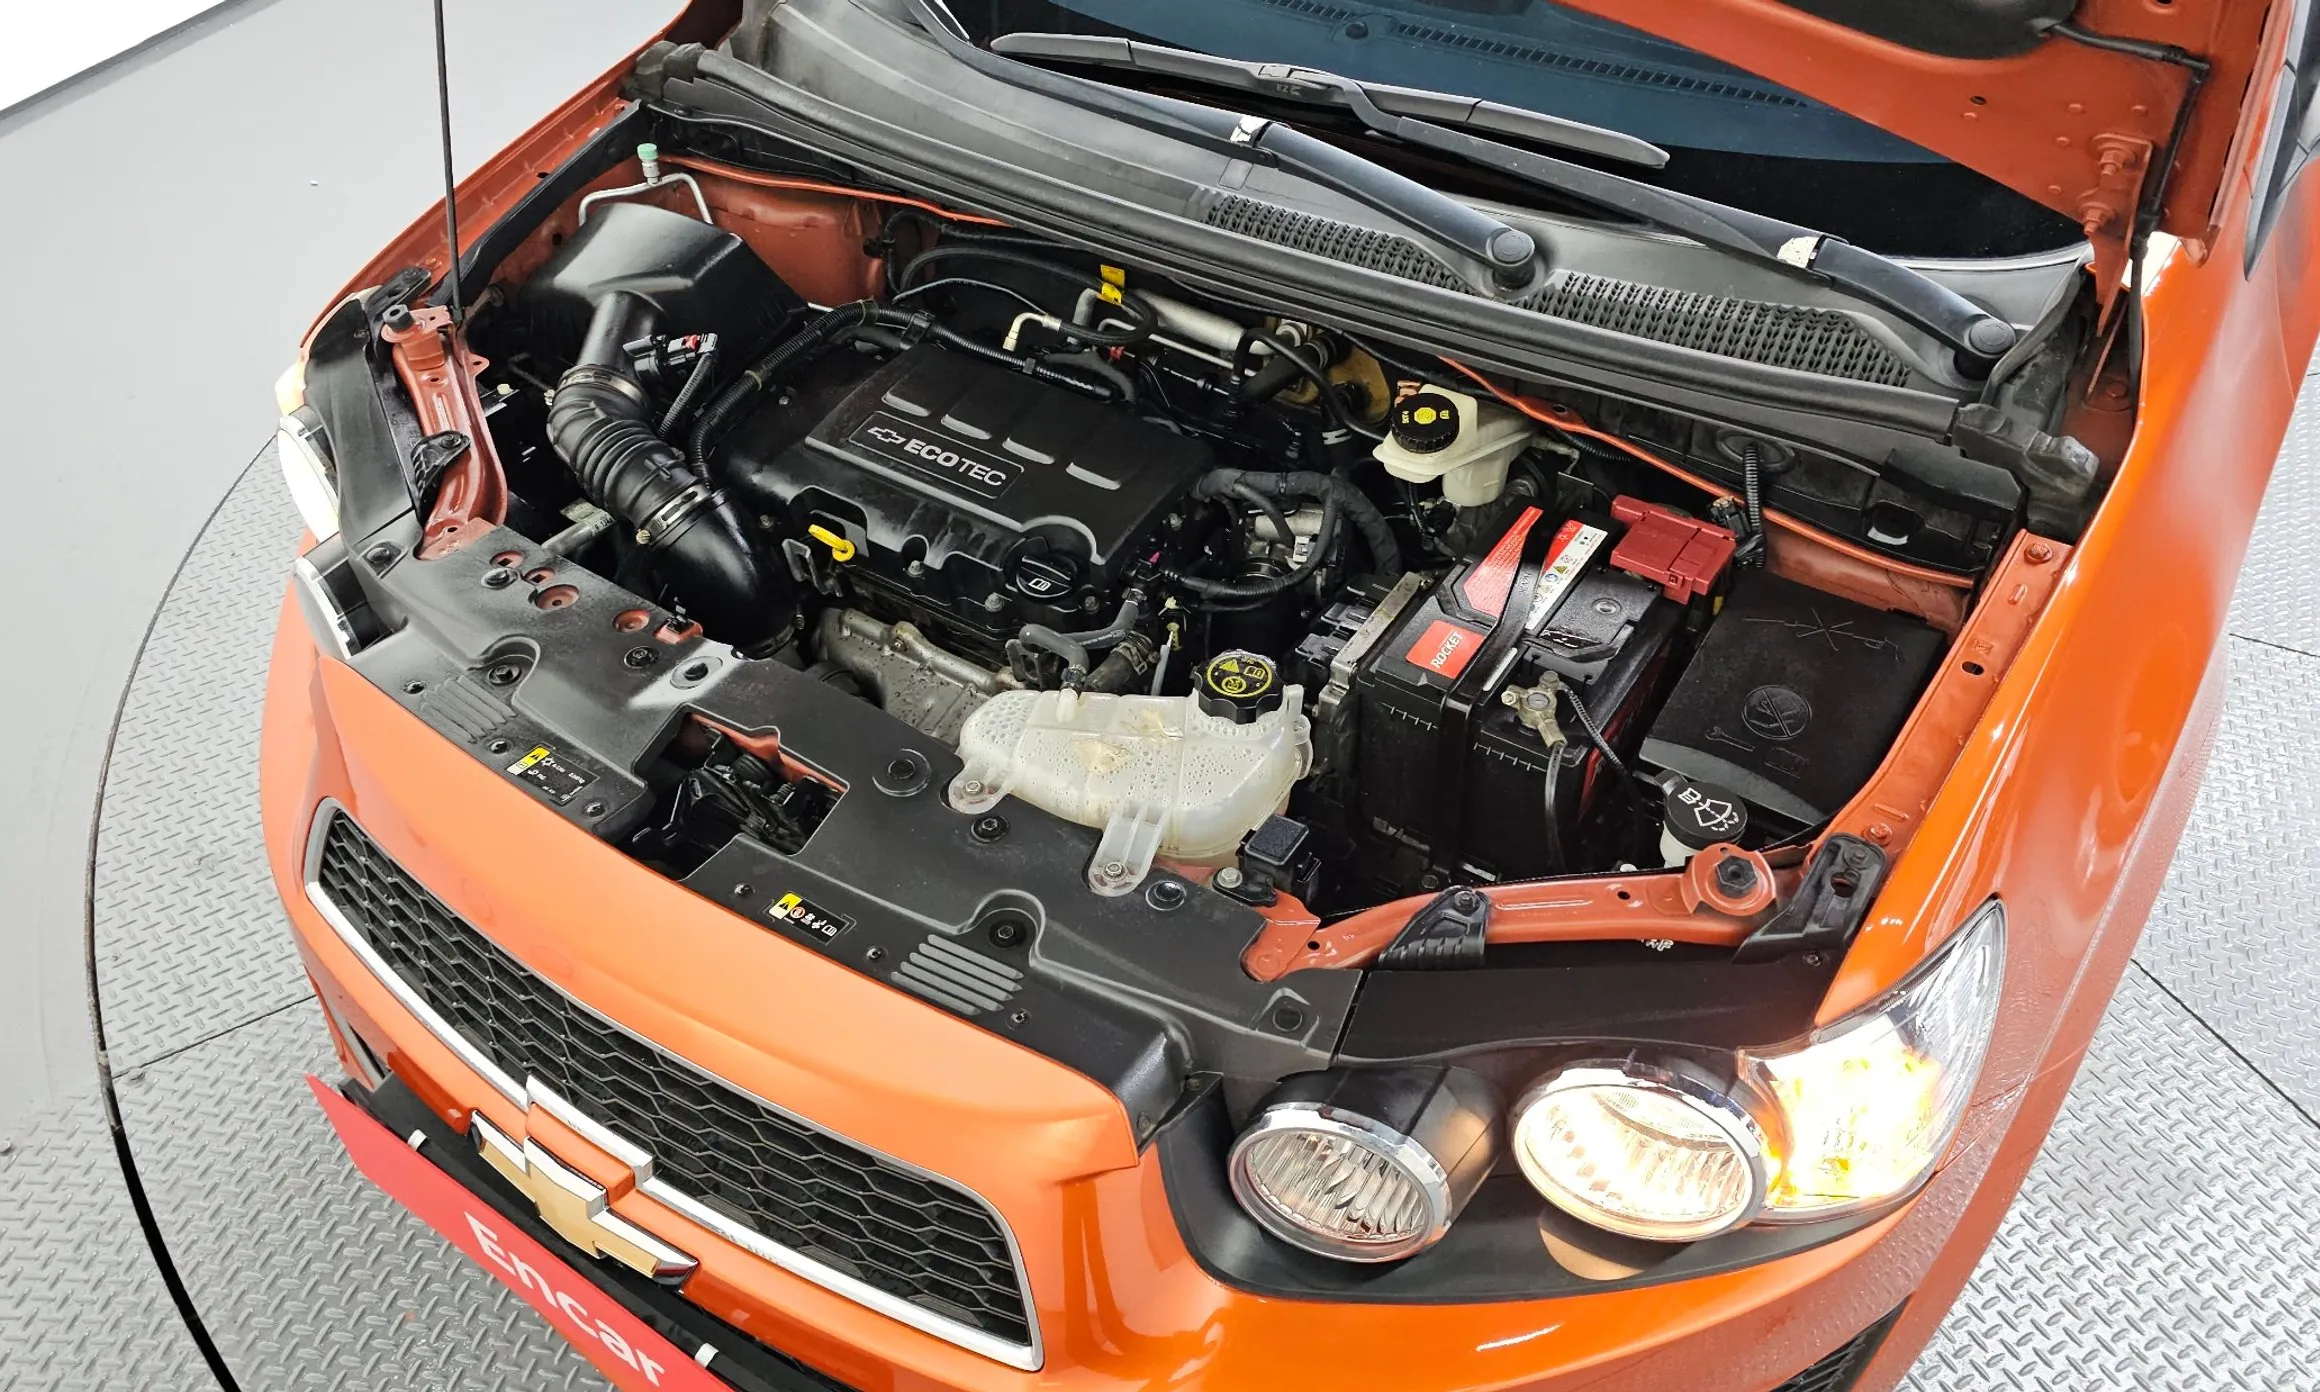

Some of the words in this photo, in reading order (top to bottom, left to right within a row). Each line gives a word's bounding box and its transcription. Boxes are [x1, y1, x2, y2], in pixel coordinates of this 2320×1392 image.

[904, 438, 1006, 486] ECOTEC
[1430, 631, 1464, 669] ROCKET
[464, 1211, 665, 1387] Encar
